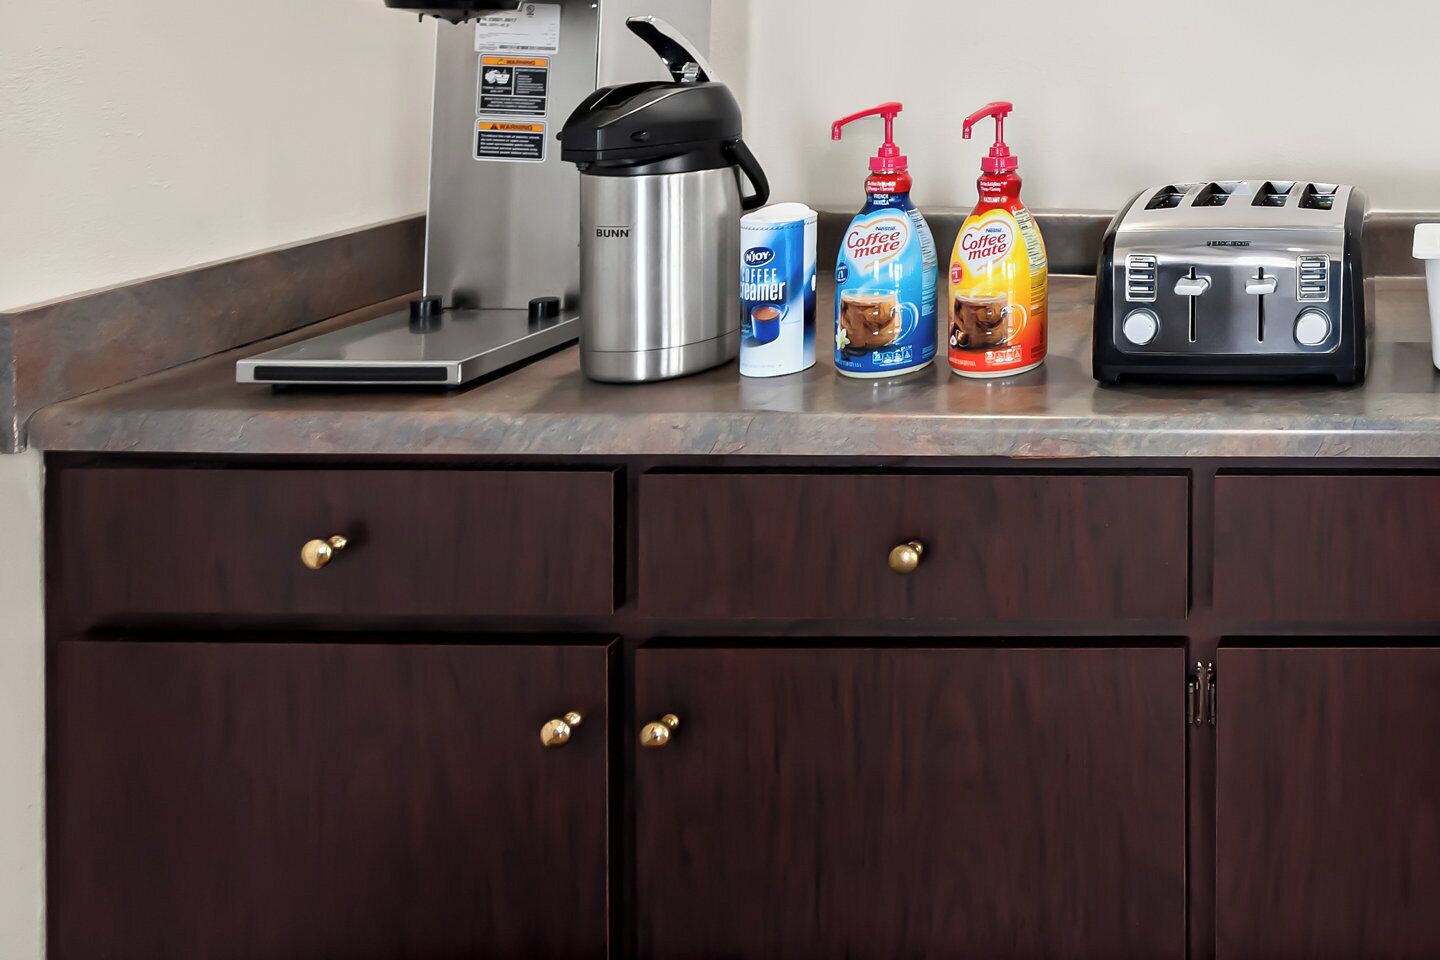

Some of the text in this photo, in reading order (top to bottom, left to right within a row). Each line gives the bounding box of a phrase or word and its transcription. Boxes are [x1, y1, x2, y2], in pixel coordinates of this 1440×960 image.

[596, 228, 629, 238] BUNN
[847, 231, 901, 249] Coffee
[854, 241, 901, 258] mate
[961, 233, 1007, 251] Coffee
[968, 243, 1007, 260] mate
[742, 268, 777, 283] OFFEE
[740, 281, 786, 301] reamer
